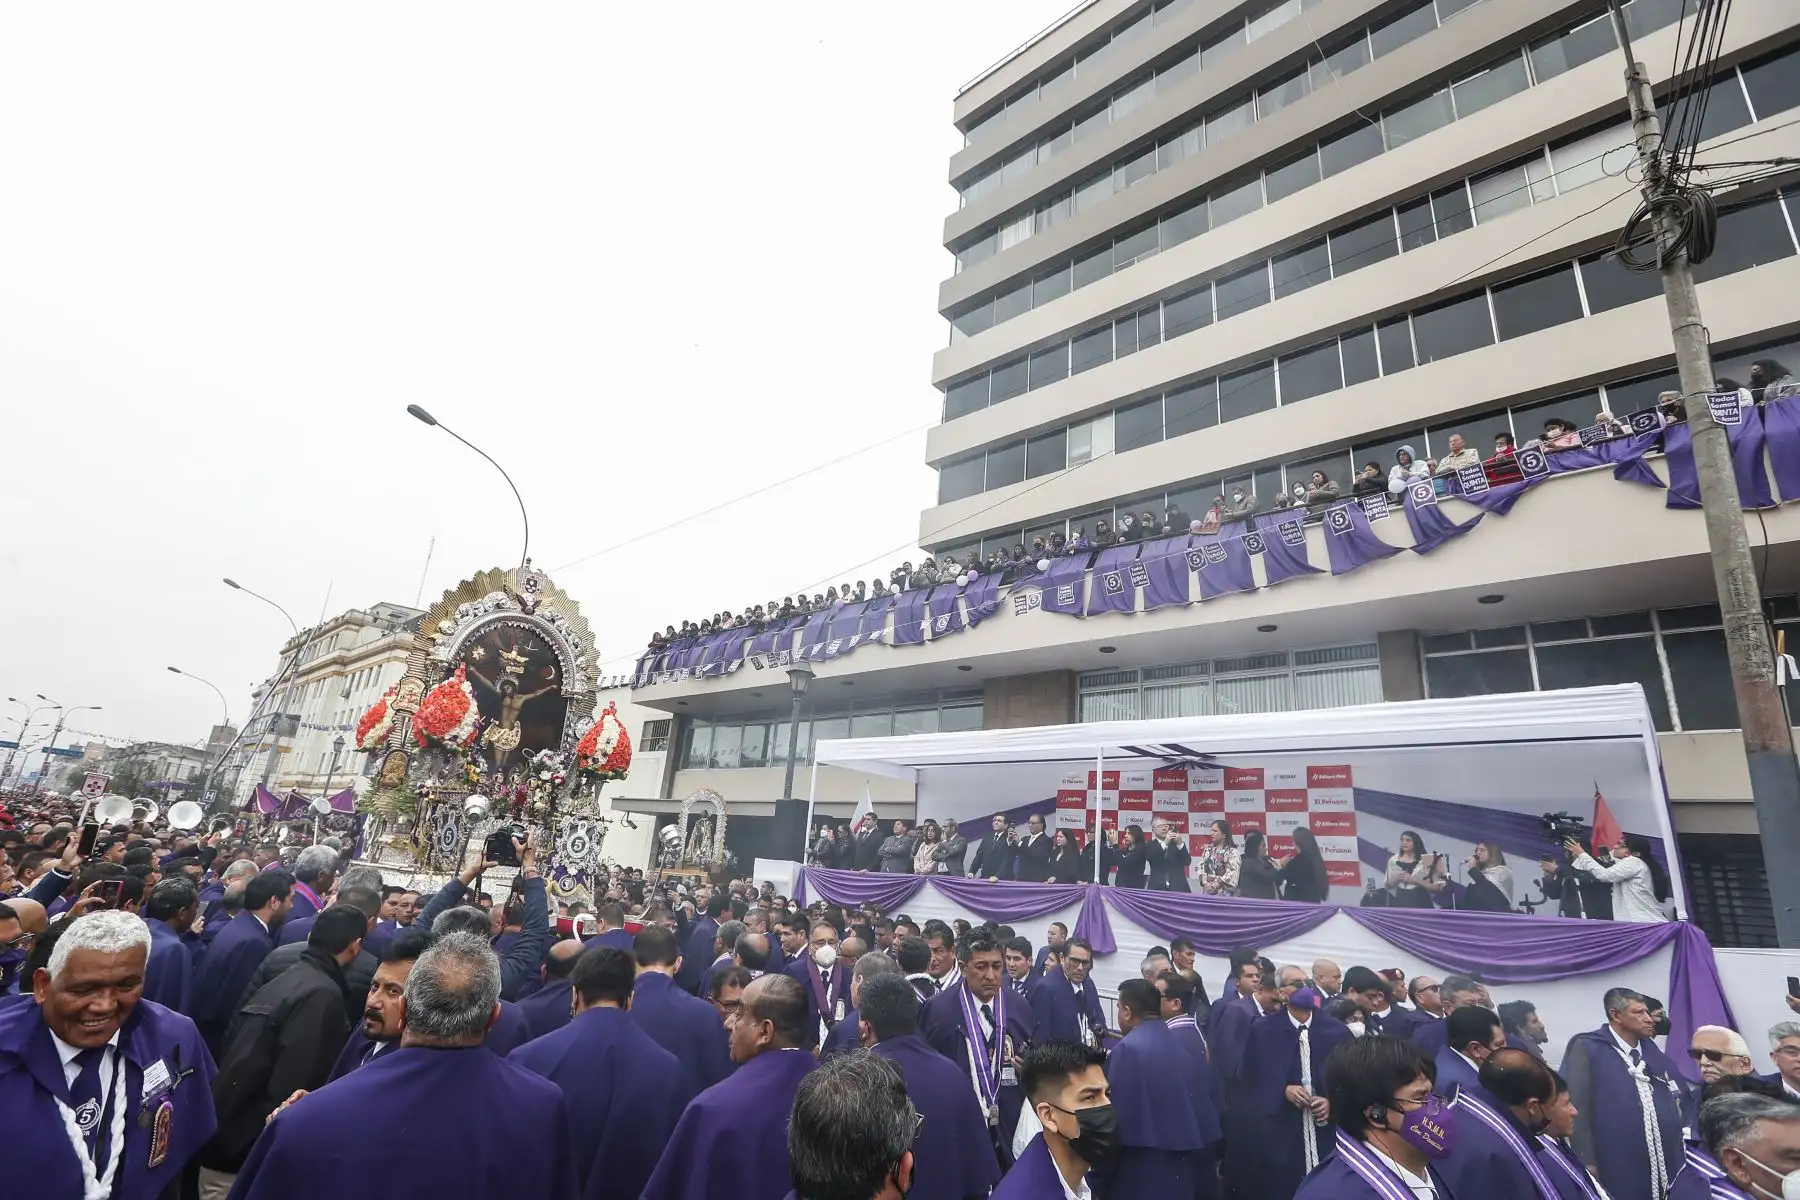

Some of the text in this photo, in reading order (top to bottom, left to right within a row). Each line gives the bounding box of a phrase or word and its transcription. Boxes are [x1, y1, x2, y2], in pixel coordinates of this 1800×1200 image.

[1640, 417, 1649, 427] 5
[1526, 456, 1536, 468] 5
[1460, 467, 1480, 476] Todos
[1461, 472, 1482, 481] Somos
[1463, 477, 1486, 489] QUINTA
[1416, 487, 1427, 498] 5
[1367, 507, 1387, 517] QUINTA
[1335, 513, 1344, 525] 5
[1250, 539, 1258, 548] 5
[1192, 556, 1200, 564] 5
[1110, 577, 1116, 587] 5
[205, 791, 215, 800] H
[573, 840, 583, 850] 5
[80, 1110, 94, 1124] 5
